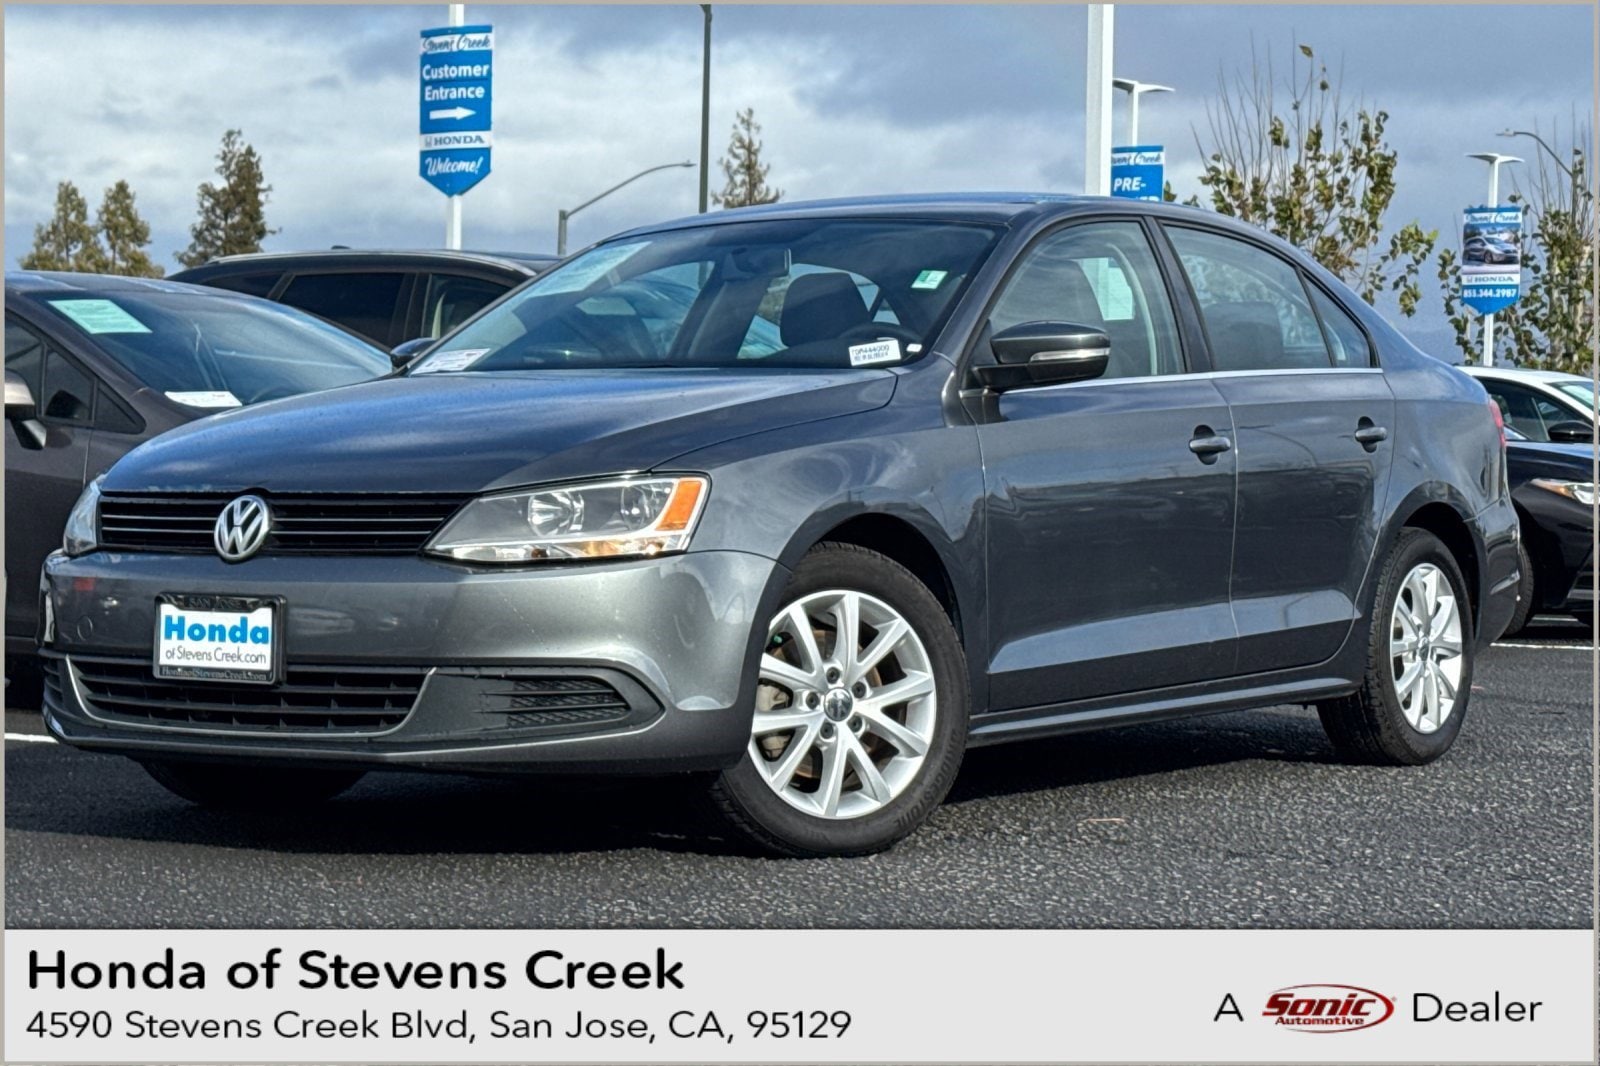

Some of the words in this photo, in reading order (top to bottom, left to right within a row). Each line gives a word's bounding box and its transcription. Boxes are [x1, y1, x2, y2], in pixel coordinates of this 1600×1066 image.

[456, 34, 491, 51] Creek
[422, 64, 490, 80] Customer
[424, 85, 485, 101] Entrance
[433, 135, 485, 146] HONDA
[425, 156, 483, 176] Welcome!
[1113, 176, 1147, 192] PRE-
[164, 615, 269, 644] Honda
[165, 647, 175, 660] of
[177, 645, 212, 662] Stevens
[214, 646, 267, 664] Creek.com
